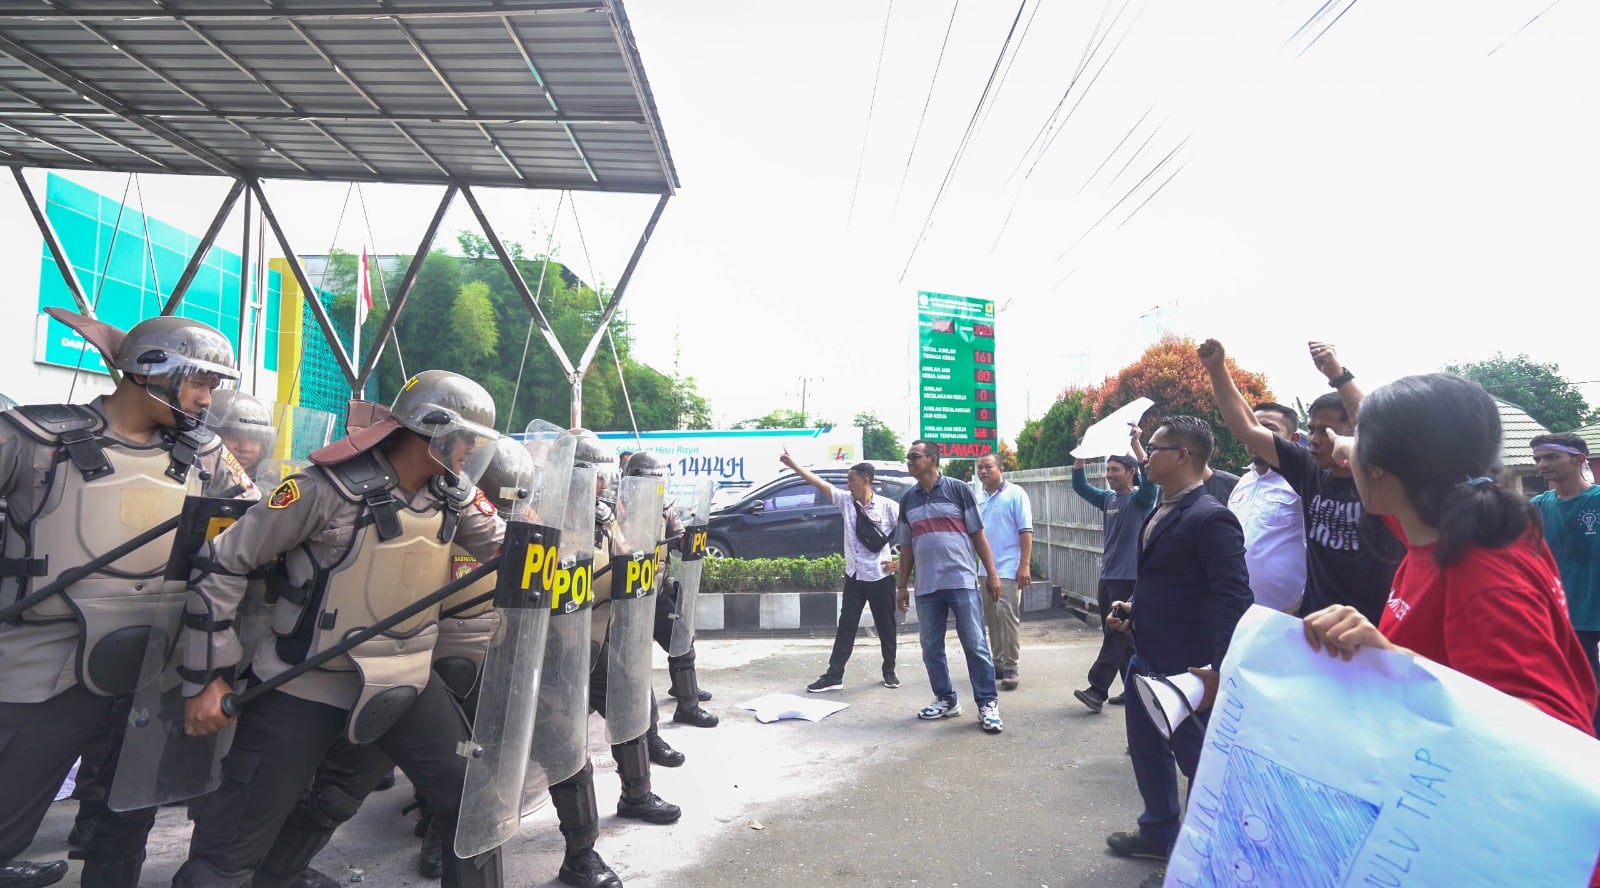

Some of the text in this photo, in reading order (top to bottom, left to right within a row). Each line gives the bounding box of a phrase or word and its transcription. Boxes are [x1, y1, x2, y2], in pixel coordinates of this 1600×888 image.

[974, 351, 992, 364] 161
[977, 370, 991, 382] 80
[655, 445, 675, 454] Hari
[677, 445, 699, 455] Raya
[1395, 747, 1453, 820] TIAP
